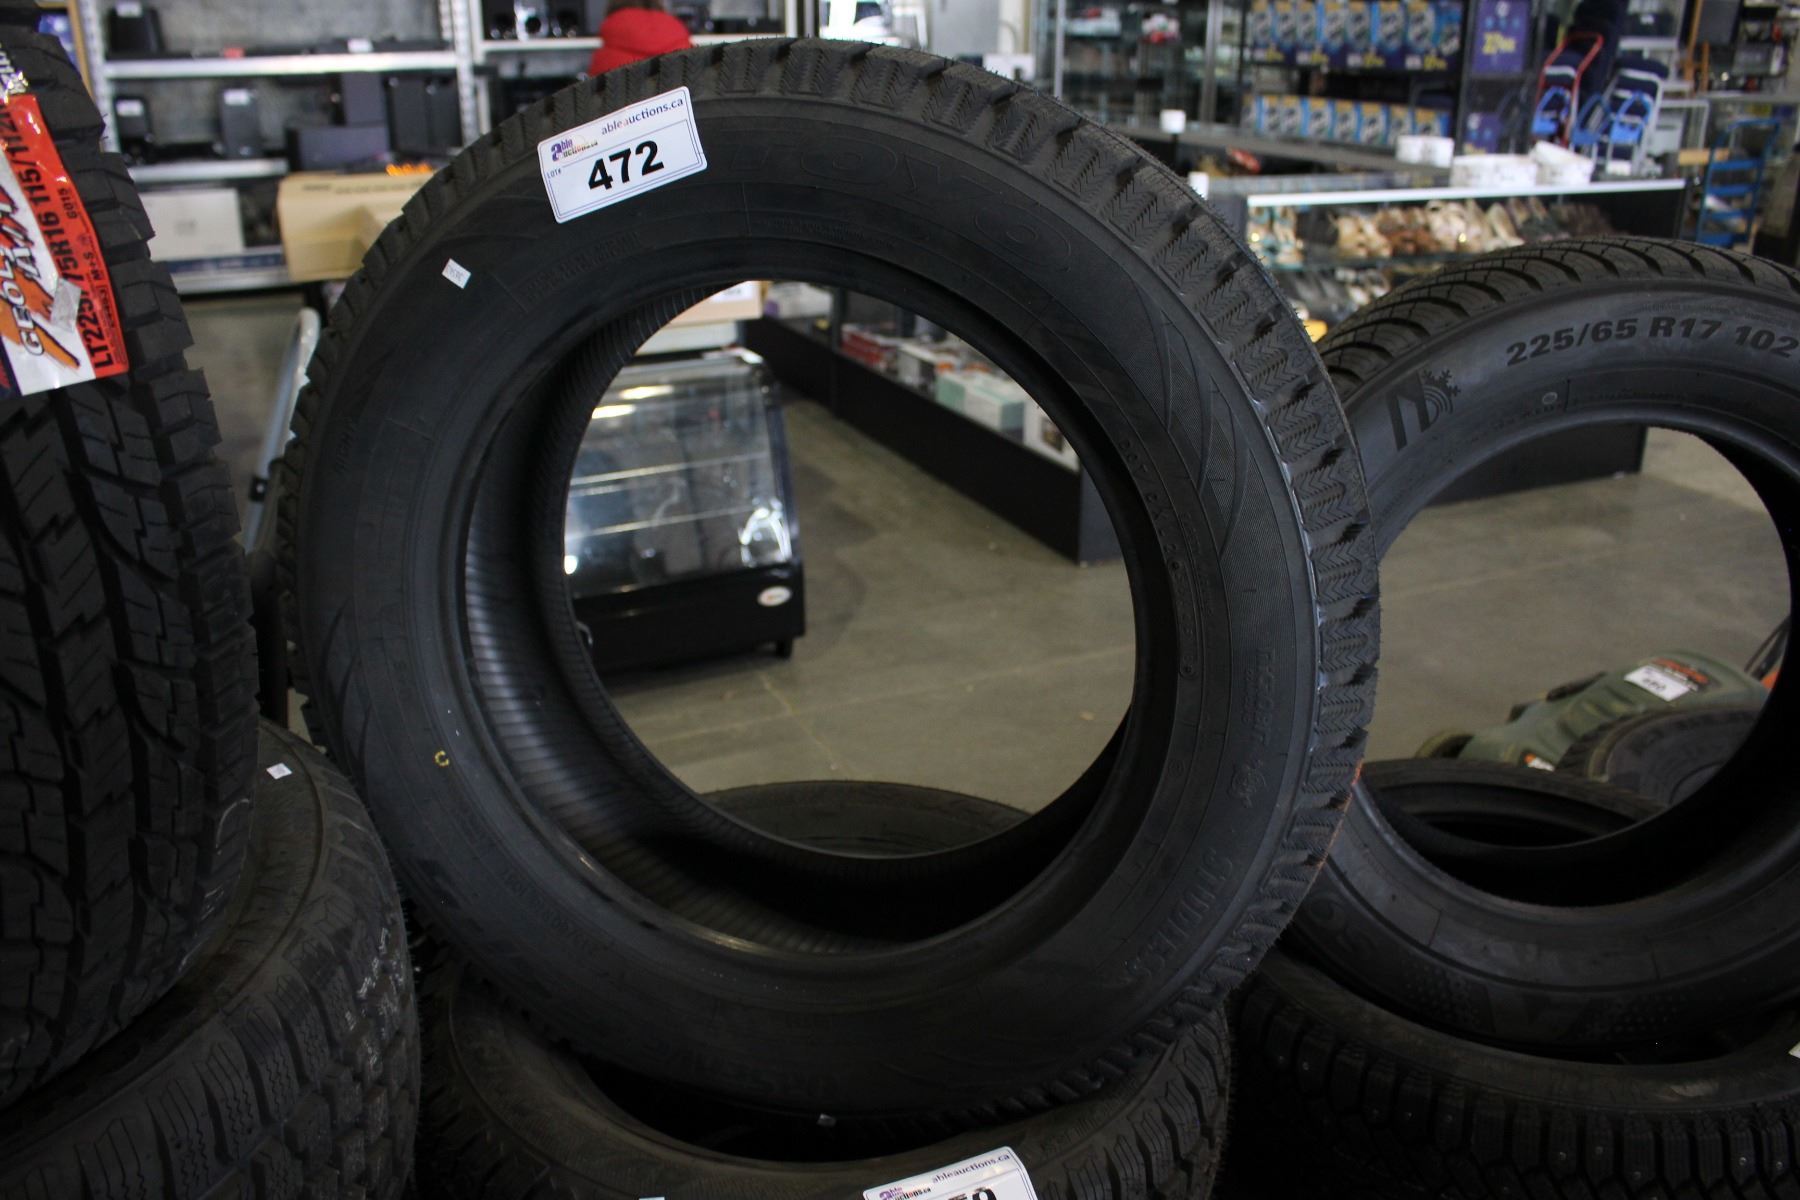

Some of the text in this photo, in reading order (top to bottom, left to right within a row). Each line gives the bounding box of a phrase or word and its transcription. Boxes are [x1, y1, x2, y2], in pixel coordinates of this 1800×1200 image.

[601, 97, 684, 136] ableauctions.ca
[588, 140, 665, 191] 472
[1506, 316, 1638, 367] 225/65
[1648, 315, 1724, 341] R17
[932, 1153, 1010, 1184] ableauctions.ca
